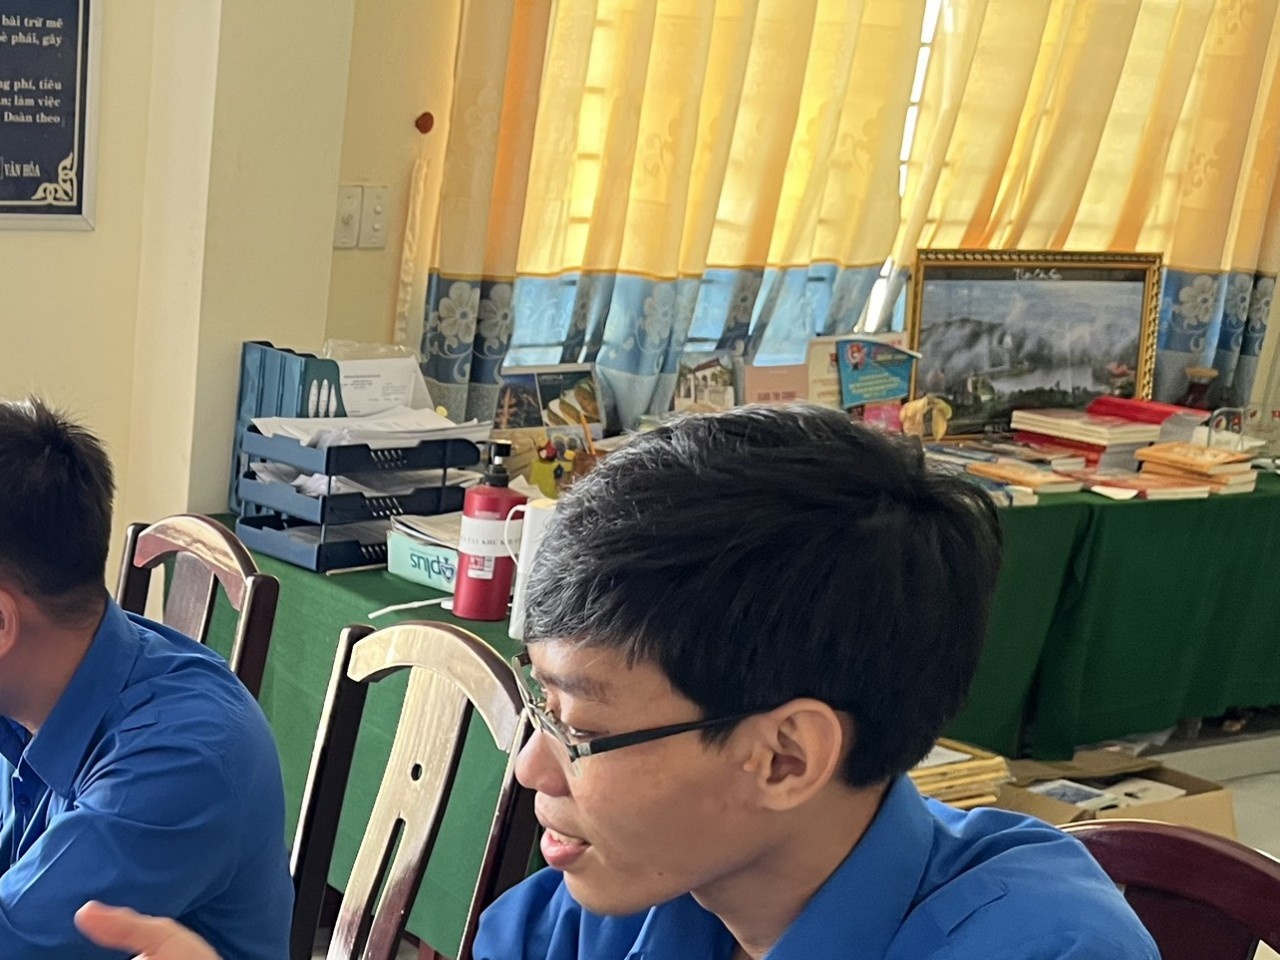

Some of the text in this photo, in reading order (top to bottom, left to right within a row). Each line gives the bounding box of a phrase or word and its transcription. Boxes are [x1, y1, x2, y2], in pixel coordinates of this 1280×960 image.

[2, 14, 20, 26] bài
[24, 17, 44, 27] trừ
[46, 18, 63, 28] mê
[11, 32, 39, 45] phái,
[42, 34, 63, 47] gây
[14, 78, 36, 91] phí,
[14, 95, 35, 106] làm
[38, 96, 61, 108] việc
[36, 112, 60, 123] theo
[410, 554, 442, 579] plus
